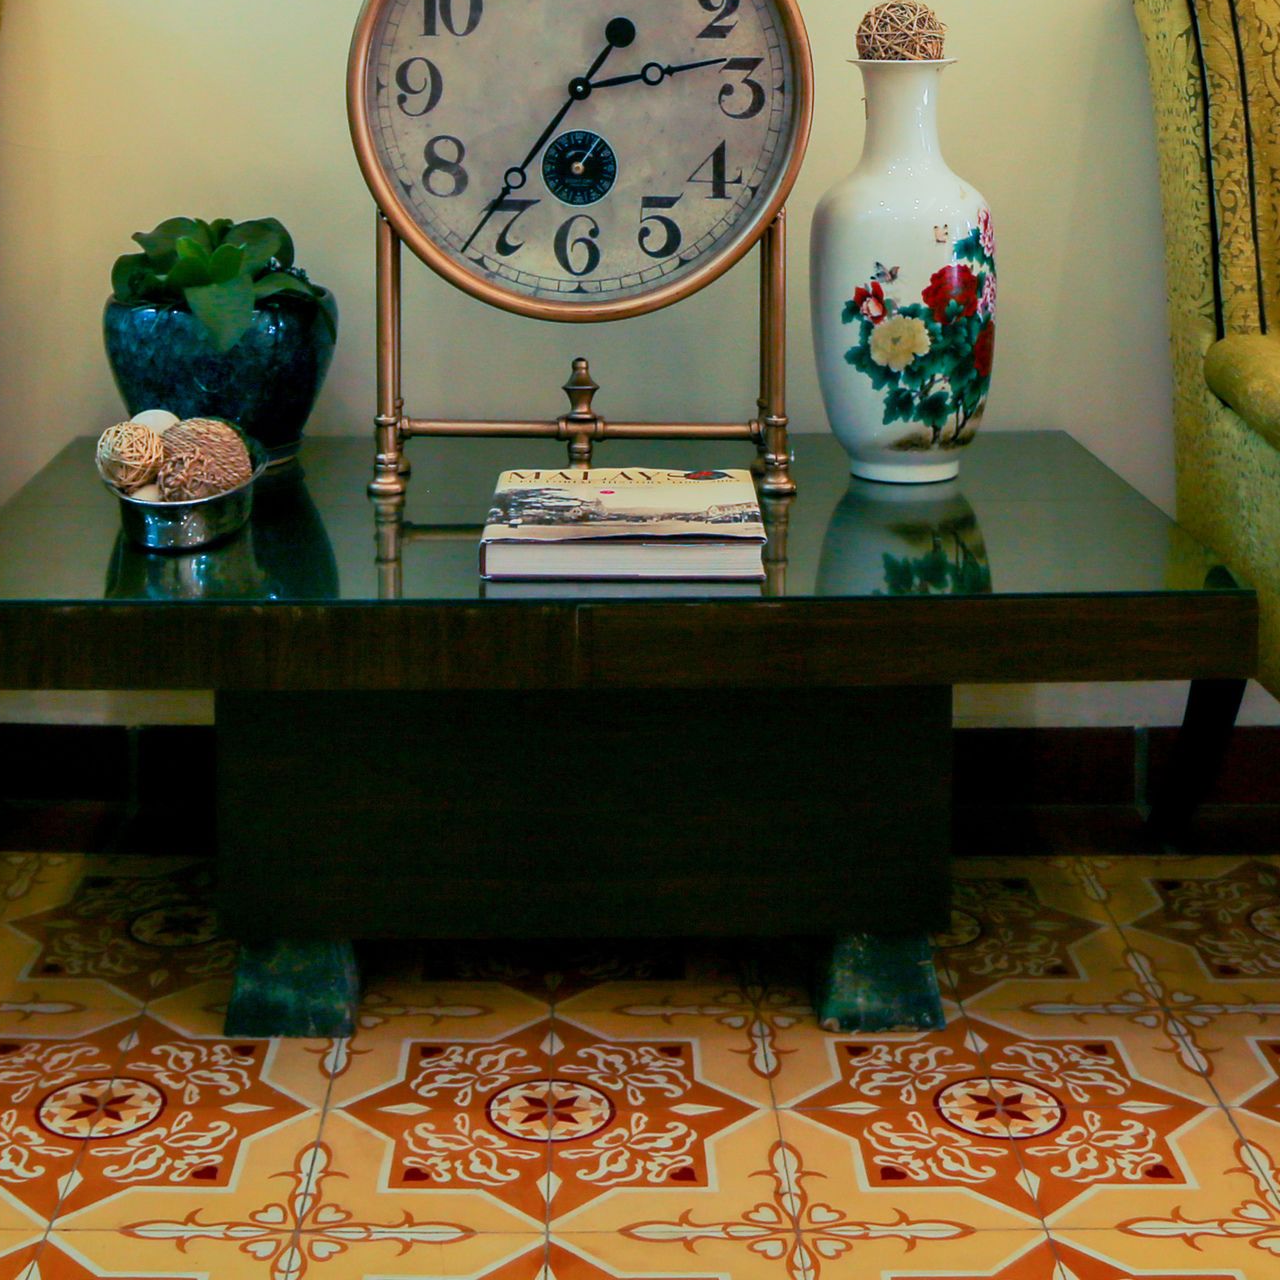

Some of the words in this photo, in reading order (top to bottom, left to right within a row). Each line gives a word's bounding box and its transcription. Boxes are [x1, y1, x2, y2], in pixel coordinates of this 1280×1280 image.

[396, 57, 442, 116] 9
[718, 57, 765, 119] 3
[422, 135, 469, 197] 8
[687, 140, 742, 199] 4
[480, 198, 541, 256] 7
[554, 215, 600, 276] 6
[637, 192, 683, 258] 5
[509, 471, 735, 481] MALAYS
